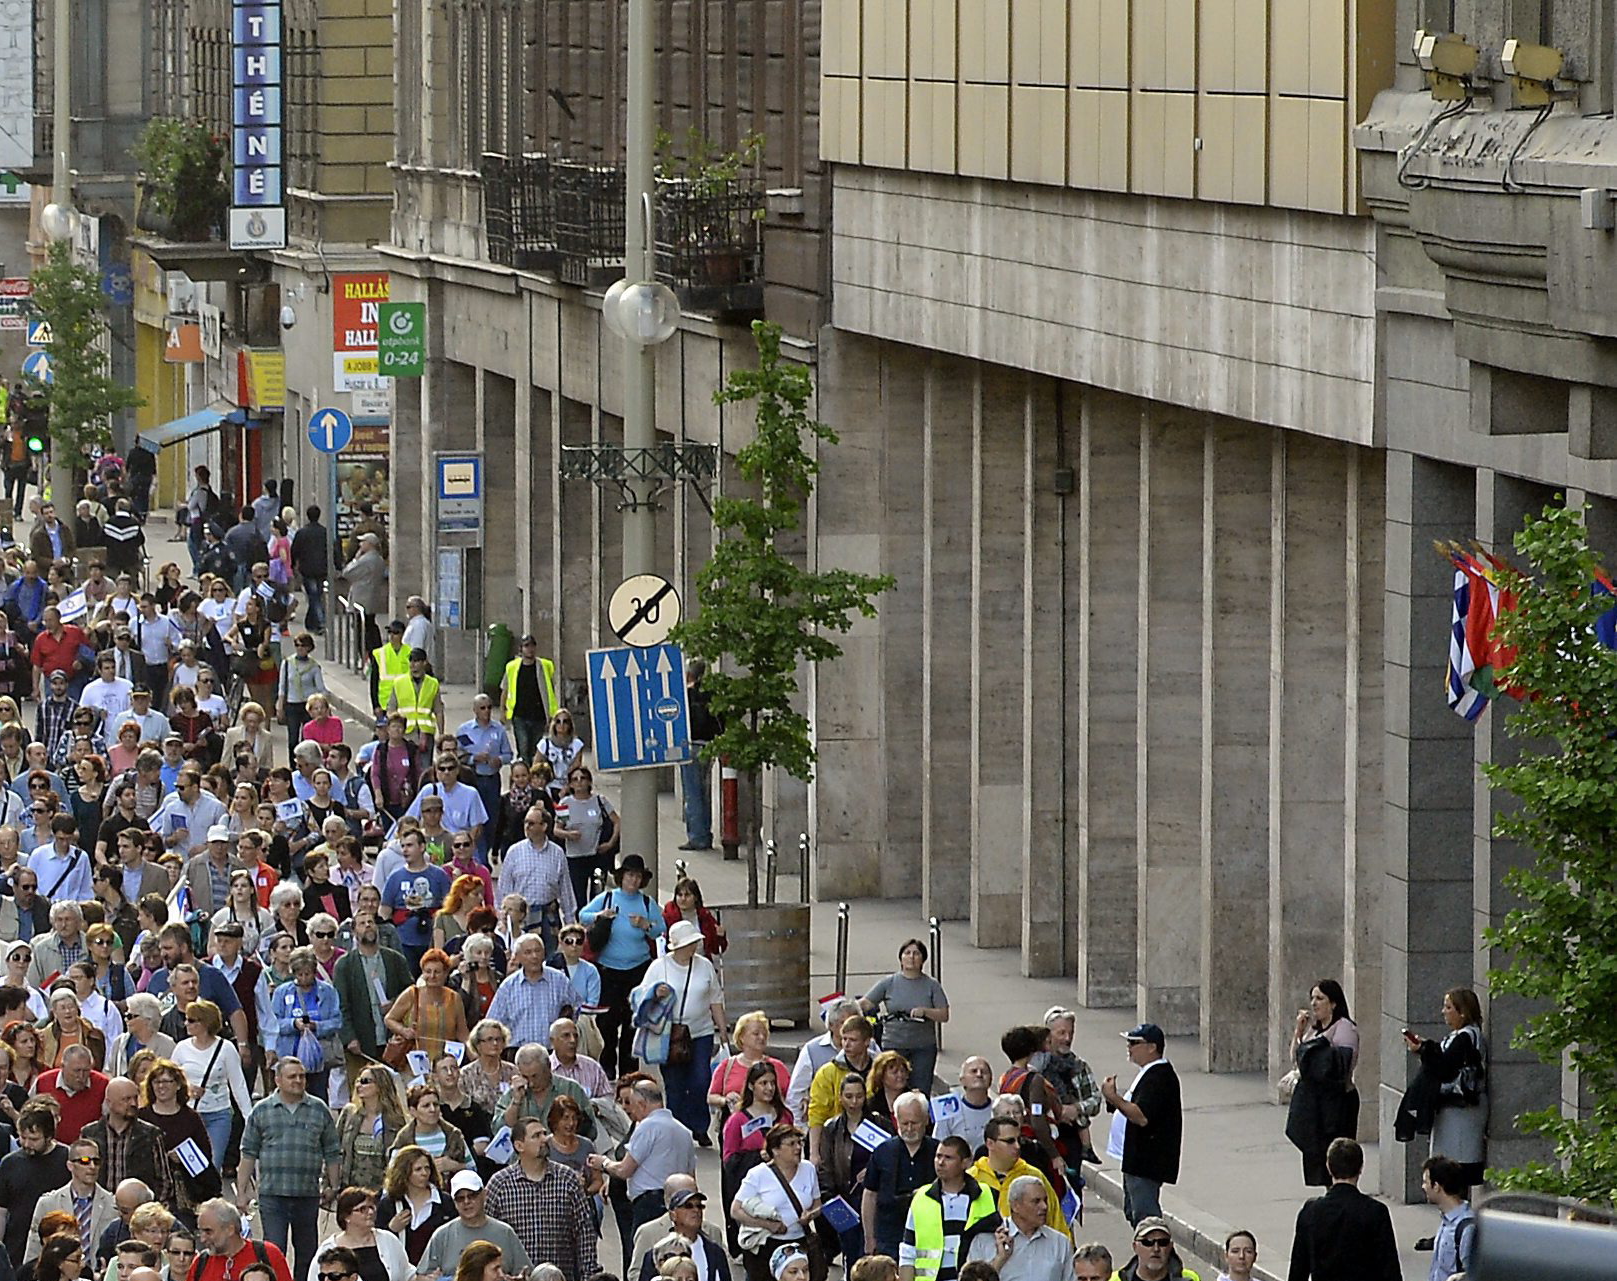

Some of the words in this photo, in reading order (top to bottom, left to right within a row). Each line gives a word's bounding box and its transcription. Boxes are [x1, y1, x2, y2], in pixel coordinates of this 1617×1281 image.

[246, 16, 267, 195] THÉNÉ
[345, 330, 378, 346] HALL
[384, 352, 420, 366] 0-24
